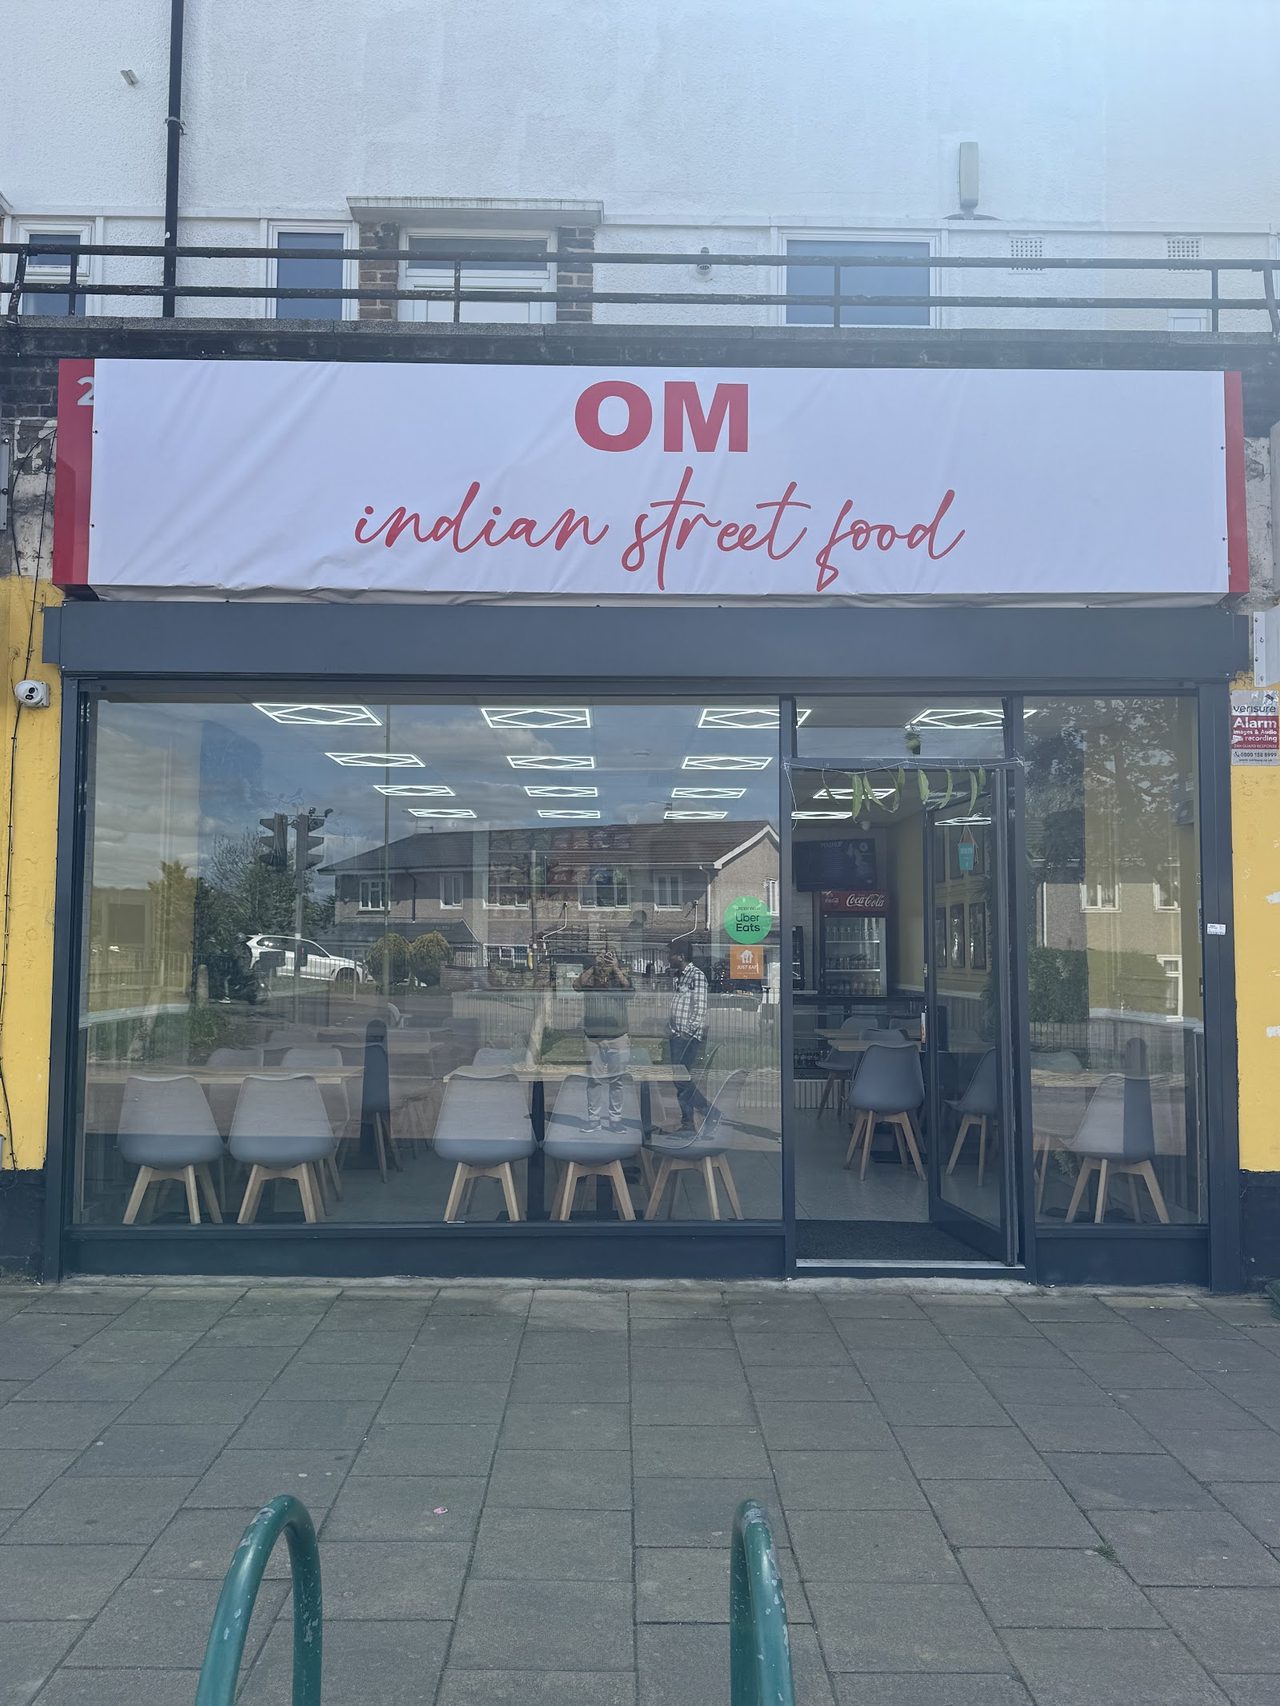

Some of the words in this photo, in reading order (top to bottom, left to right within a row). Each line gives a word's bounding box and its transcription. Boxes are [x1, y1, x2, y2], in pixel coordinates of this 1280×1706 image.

[575, 380, 749, 453] OM
[355, 481, 609, 553] indian
[620, 466, 812, 592] street
[815, 490, 966, 593] food
[1233, 705, 1276, 713] verisure
[1233, 717, 1277, 728] Alarm
[1244, 735, 1277, 743] recording
[846, 893, 885, 907] Coca-Cola
[736, 913, 760, 922] Uber
[736, 923, 761, 932] Eats
